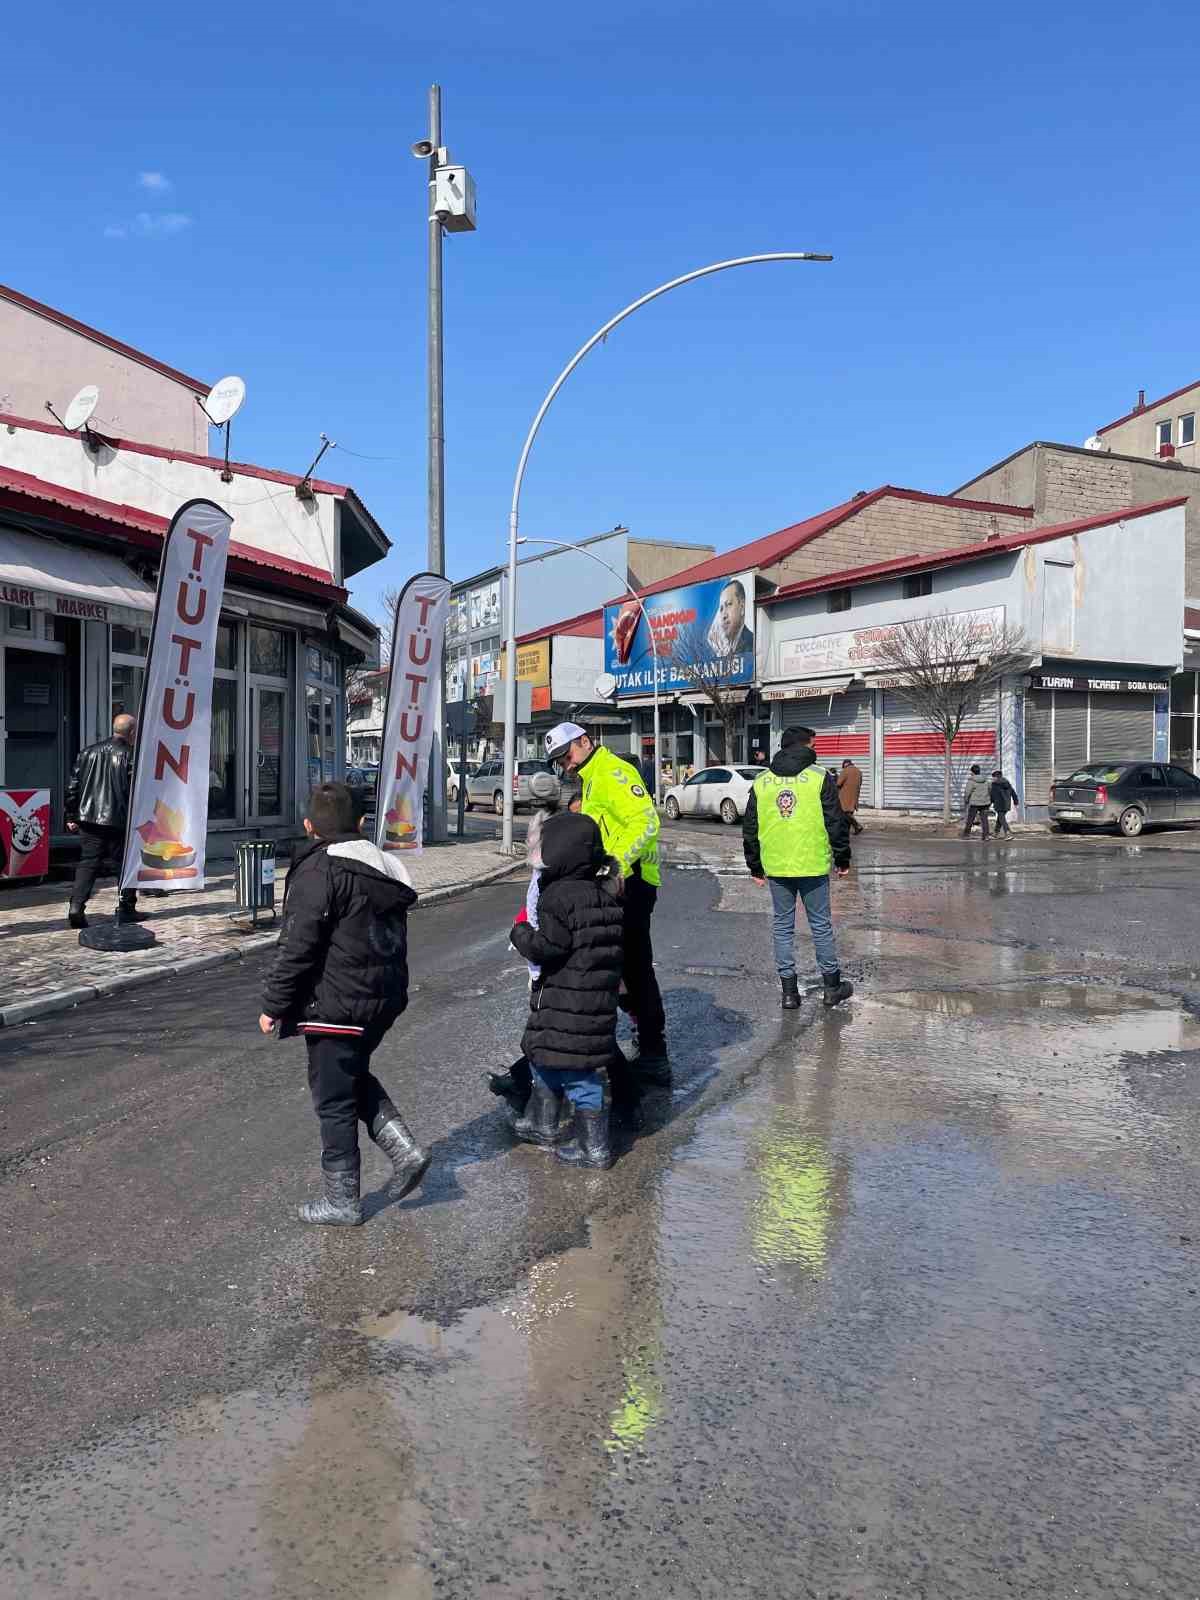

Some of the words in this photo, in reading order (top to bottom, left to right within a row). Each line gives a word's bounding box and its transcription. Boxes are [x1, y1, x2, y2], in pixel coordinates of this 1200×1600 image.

[154, 526, 214, 786] TÜTÜN
[394, 595, 438, 782] TÜTÜN
[1040, 676, 1074, 688] TURAN
[1127, 681, 1147, 690] SOBA
